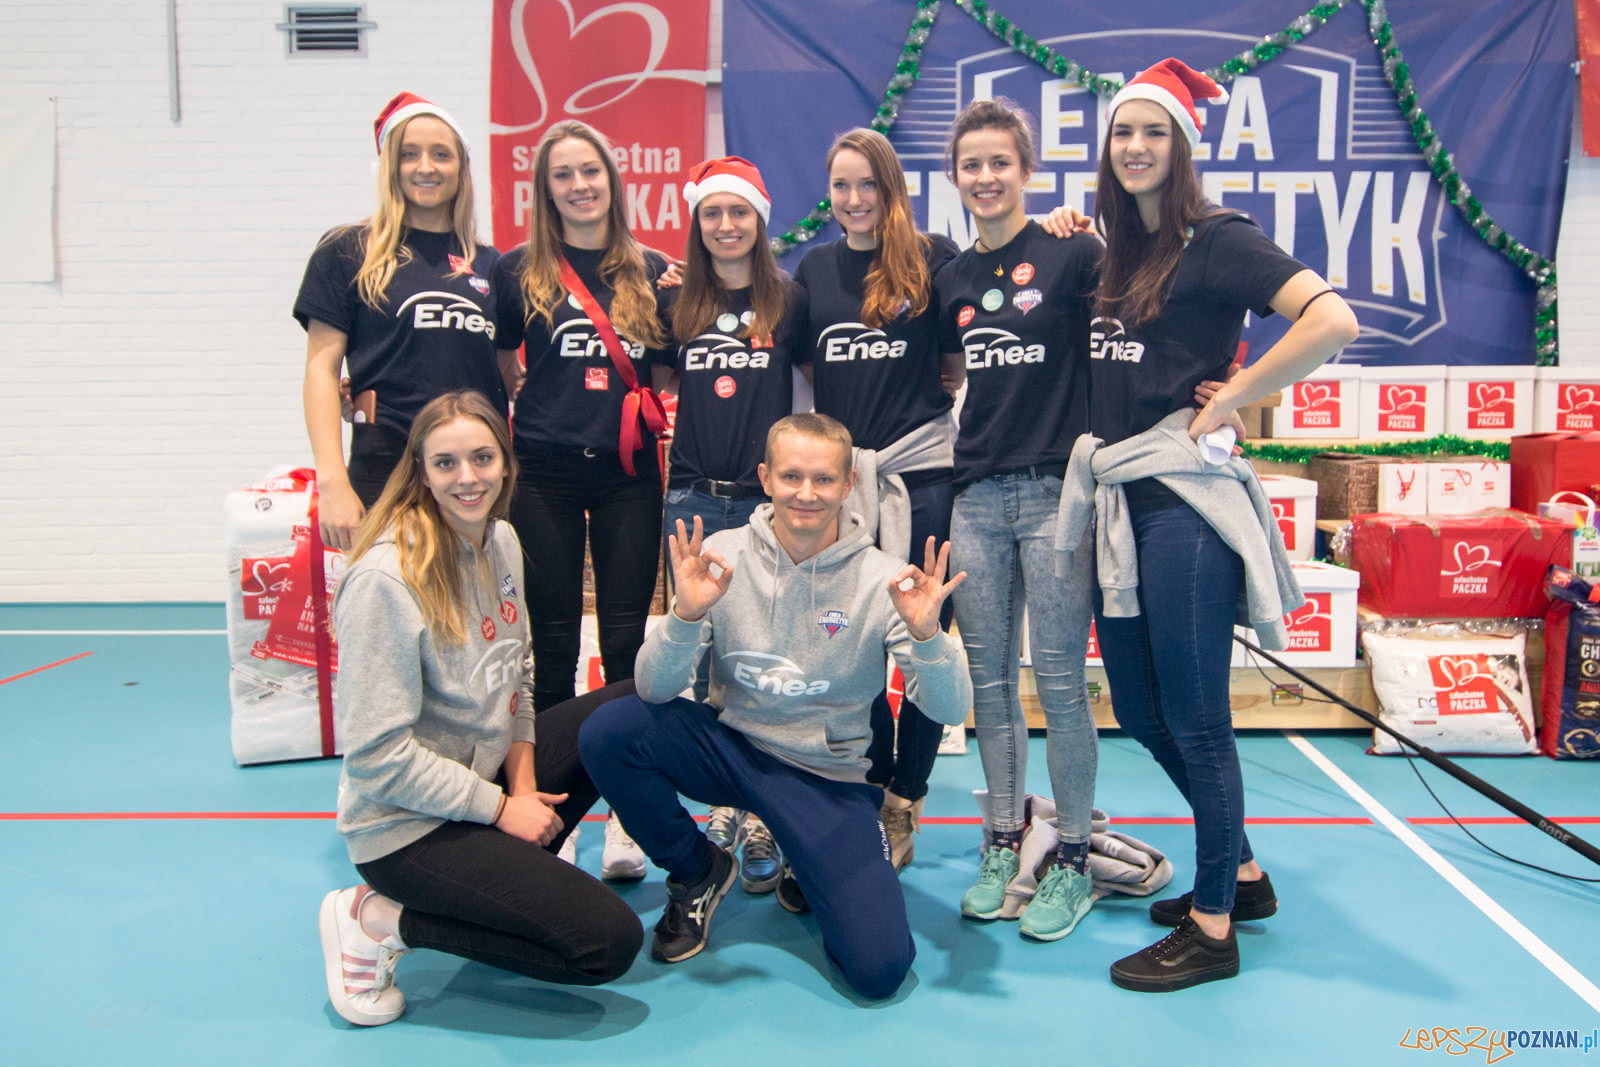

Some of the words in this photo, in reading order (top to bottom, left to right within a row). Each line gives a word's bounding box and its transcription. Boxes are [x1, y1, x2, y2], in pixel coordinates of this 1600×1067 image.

[1041, 71, 1274, 161] EA
[512, 142, 681, 174] setna
[513, 181, 681, 231] PKA
[414, 303, 496, 341] Enea
[685, 347, 770, 371] Enea
[825, 337, 908, 362] Enea
[964, 343, 1046, 370] Enea
[1453, 583, 1487, 594] PACZKA
[1289, 636, 1320, 648] ACZKA
[485, 652, 520, 695] En
[734, 662, 831, 697] Enea
[1449, 698, 1488, 711] PACZKA
